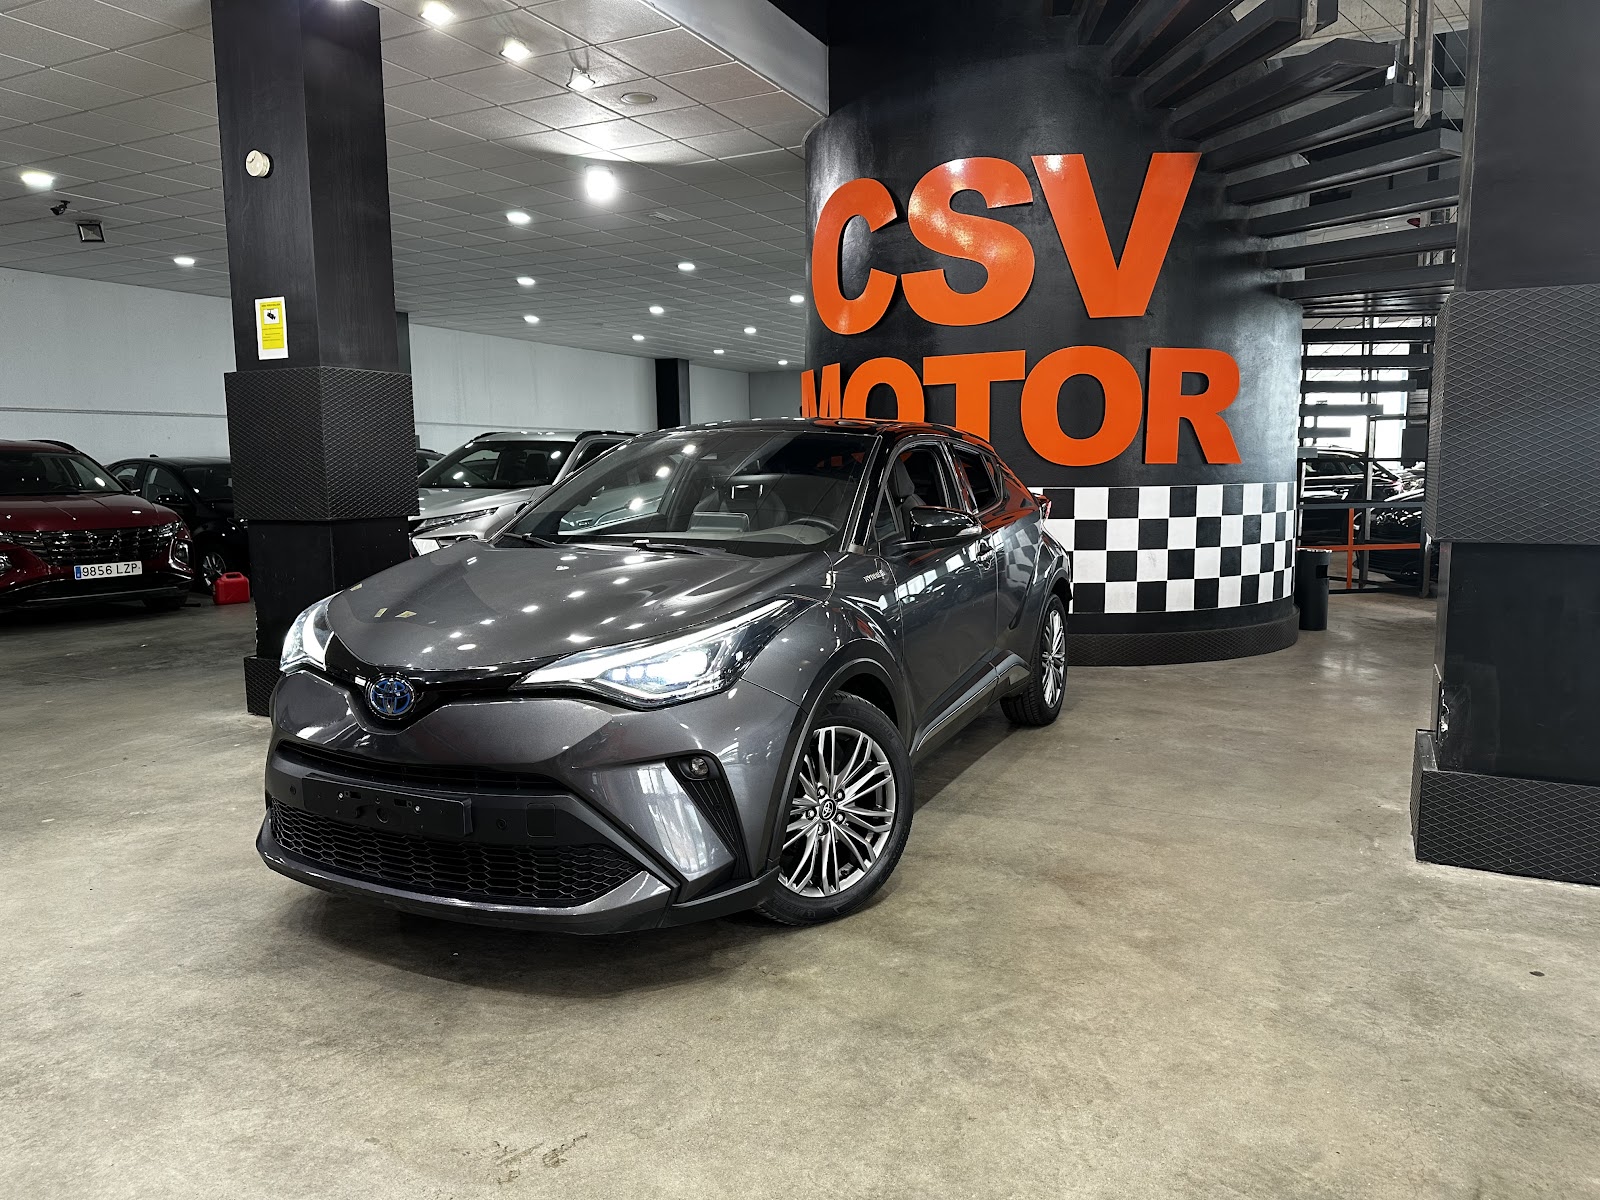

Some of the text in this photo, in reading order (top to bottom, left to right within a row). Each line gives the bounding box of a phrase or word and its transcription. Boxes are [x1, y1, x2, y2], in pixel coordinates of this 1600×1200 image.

[811, 151, 1202, 335] CSV
[82, 563, 138, 577] 9856 LZP
